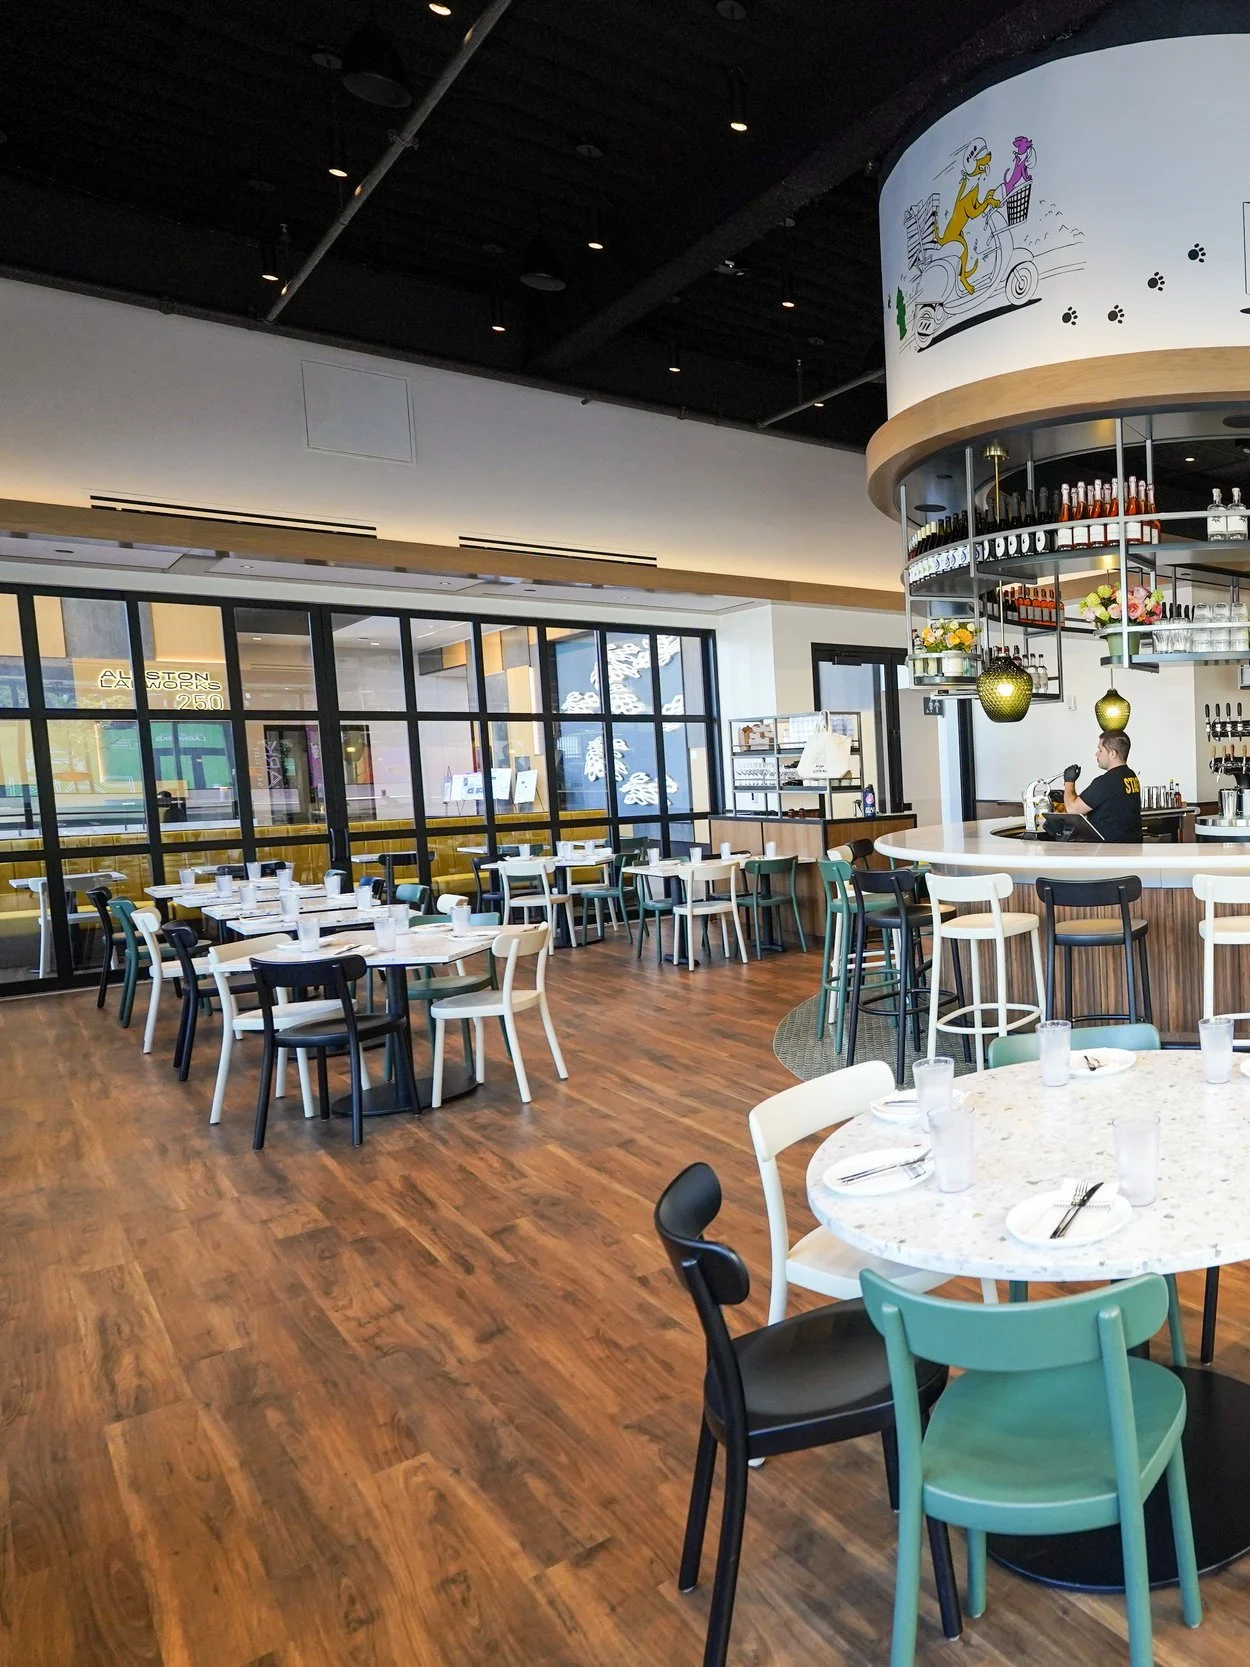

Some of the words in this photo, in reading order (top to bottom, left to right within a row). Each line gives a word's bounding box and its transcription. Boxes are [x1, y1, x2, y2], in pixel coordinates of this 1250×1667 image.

[100, 669, 209, 681] ALSTON
[100, 679, 222, 691] LAWORKS
[177, 694, 224, 710] 250
[1123, 777, 1140, 794] STA
